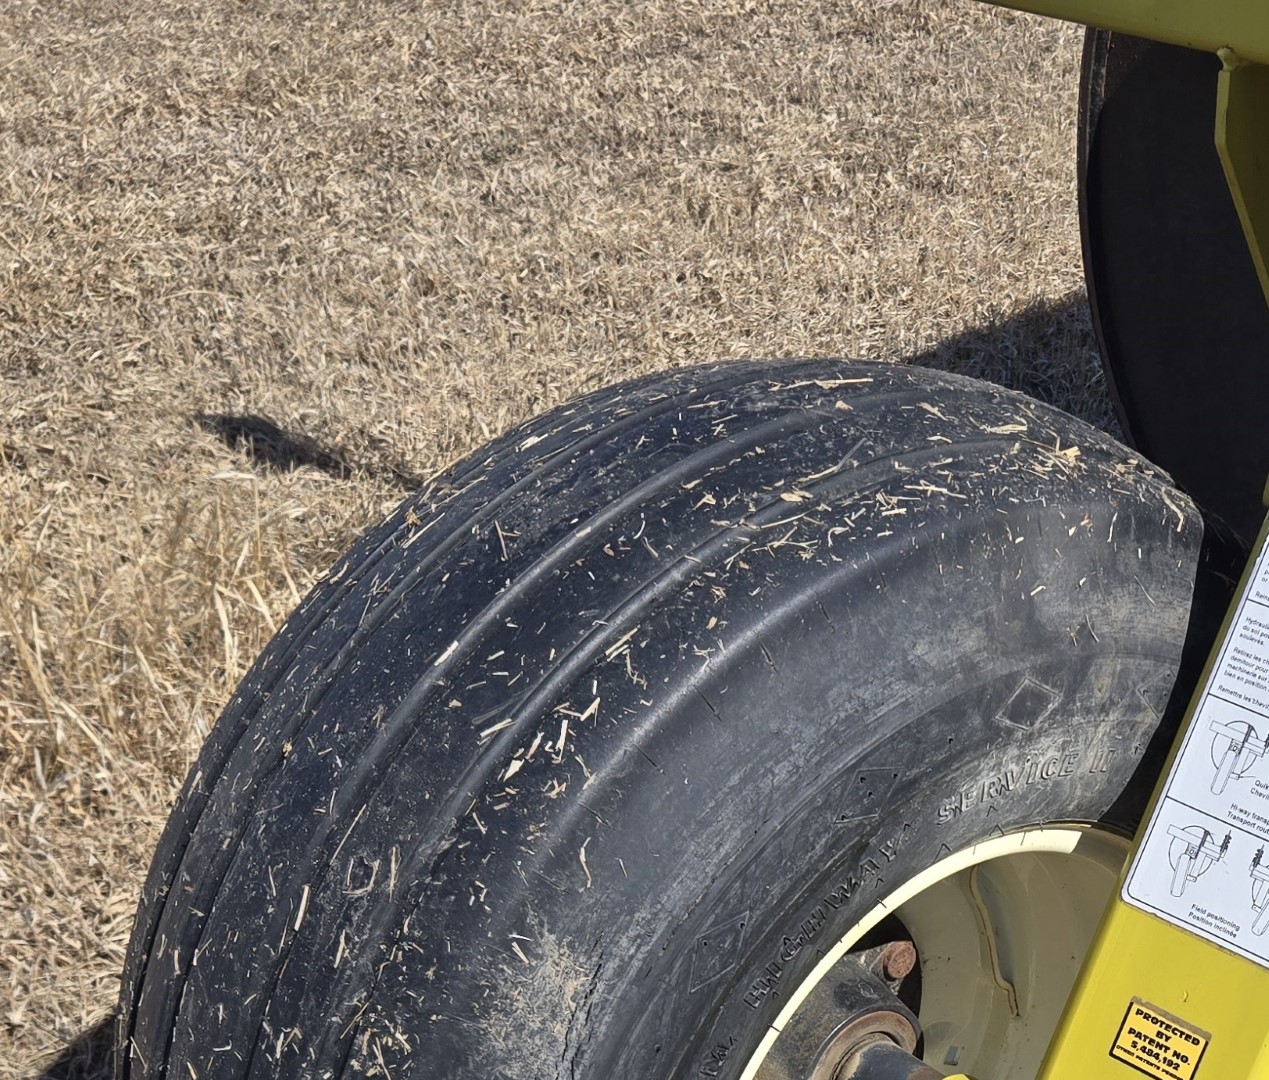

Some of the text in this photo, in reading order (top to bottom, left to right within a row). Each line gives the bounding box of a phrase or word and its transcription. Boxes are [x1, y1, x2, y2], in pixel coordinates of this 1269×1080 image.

[1250, 627, 1260, 635] sol
[1252, 654, 1261, 662] les
[1226, 662, 1257, 678] machinerie
[1257, 674, 1267, 682] sur
[1254, 664, 1268, 674] pour
[1223, 669, 1236, 678] bien
[1243, 678, 1267, 691] position
[1217, 684, 1242, 699] Remettre
[1242, 694, 1251, 702] les
[1226, 810, 1256, 829] Transport
[1229, 802, 1251, 817] Hi-way
[741, 838, 901, 1012] HIGHWAY
[935, 748, 1079, 827] SERVICE
[1187, 911, 1237, 938] Position inclinée
[1190, 903, 1240, 932] Field positioning
[1134, 1007, 1200, 1046] PROTECTED
[1154, 1029, 1172, 1043] BY
[1127, 1026, 1191, 1065] PATENT NO.
[1130, 1039, 1180, 1071] 5,484,192
